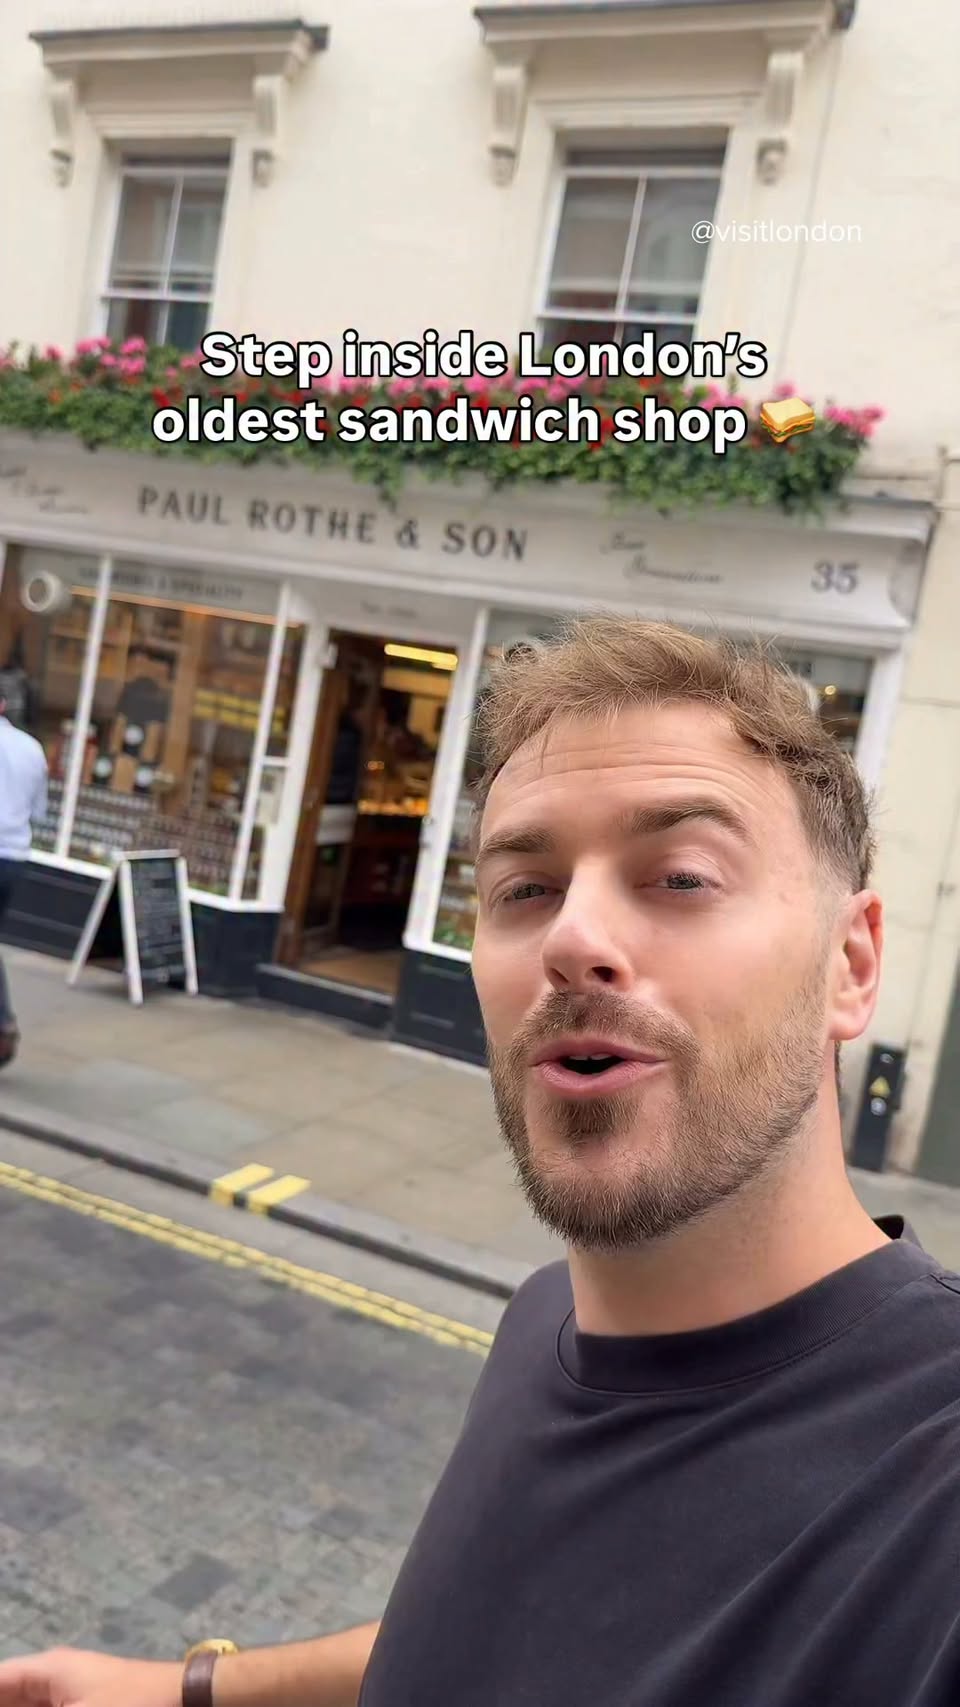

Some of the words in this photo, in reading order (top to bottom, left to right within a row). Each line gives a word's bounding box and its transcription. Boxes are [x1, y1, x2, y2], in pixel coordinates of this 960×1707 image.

[137, 485, 230, 527] PAUL
[248, 501, 376, 544] ROTHE
[396, 519, 421, 550] &
[441, 521, 529, 562] SON
[811, 560, 860, 594] 35
